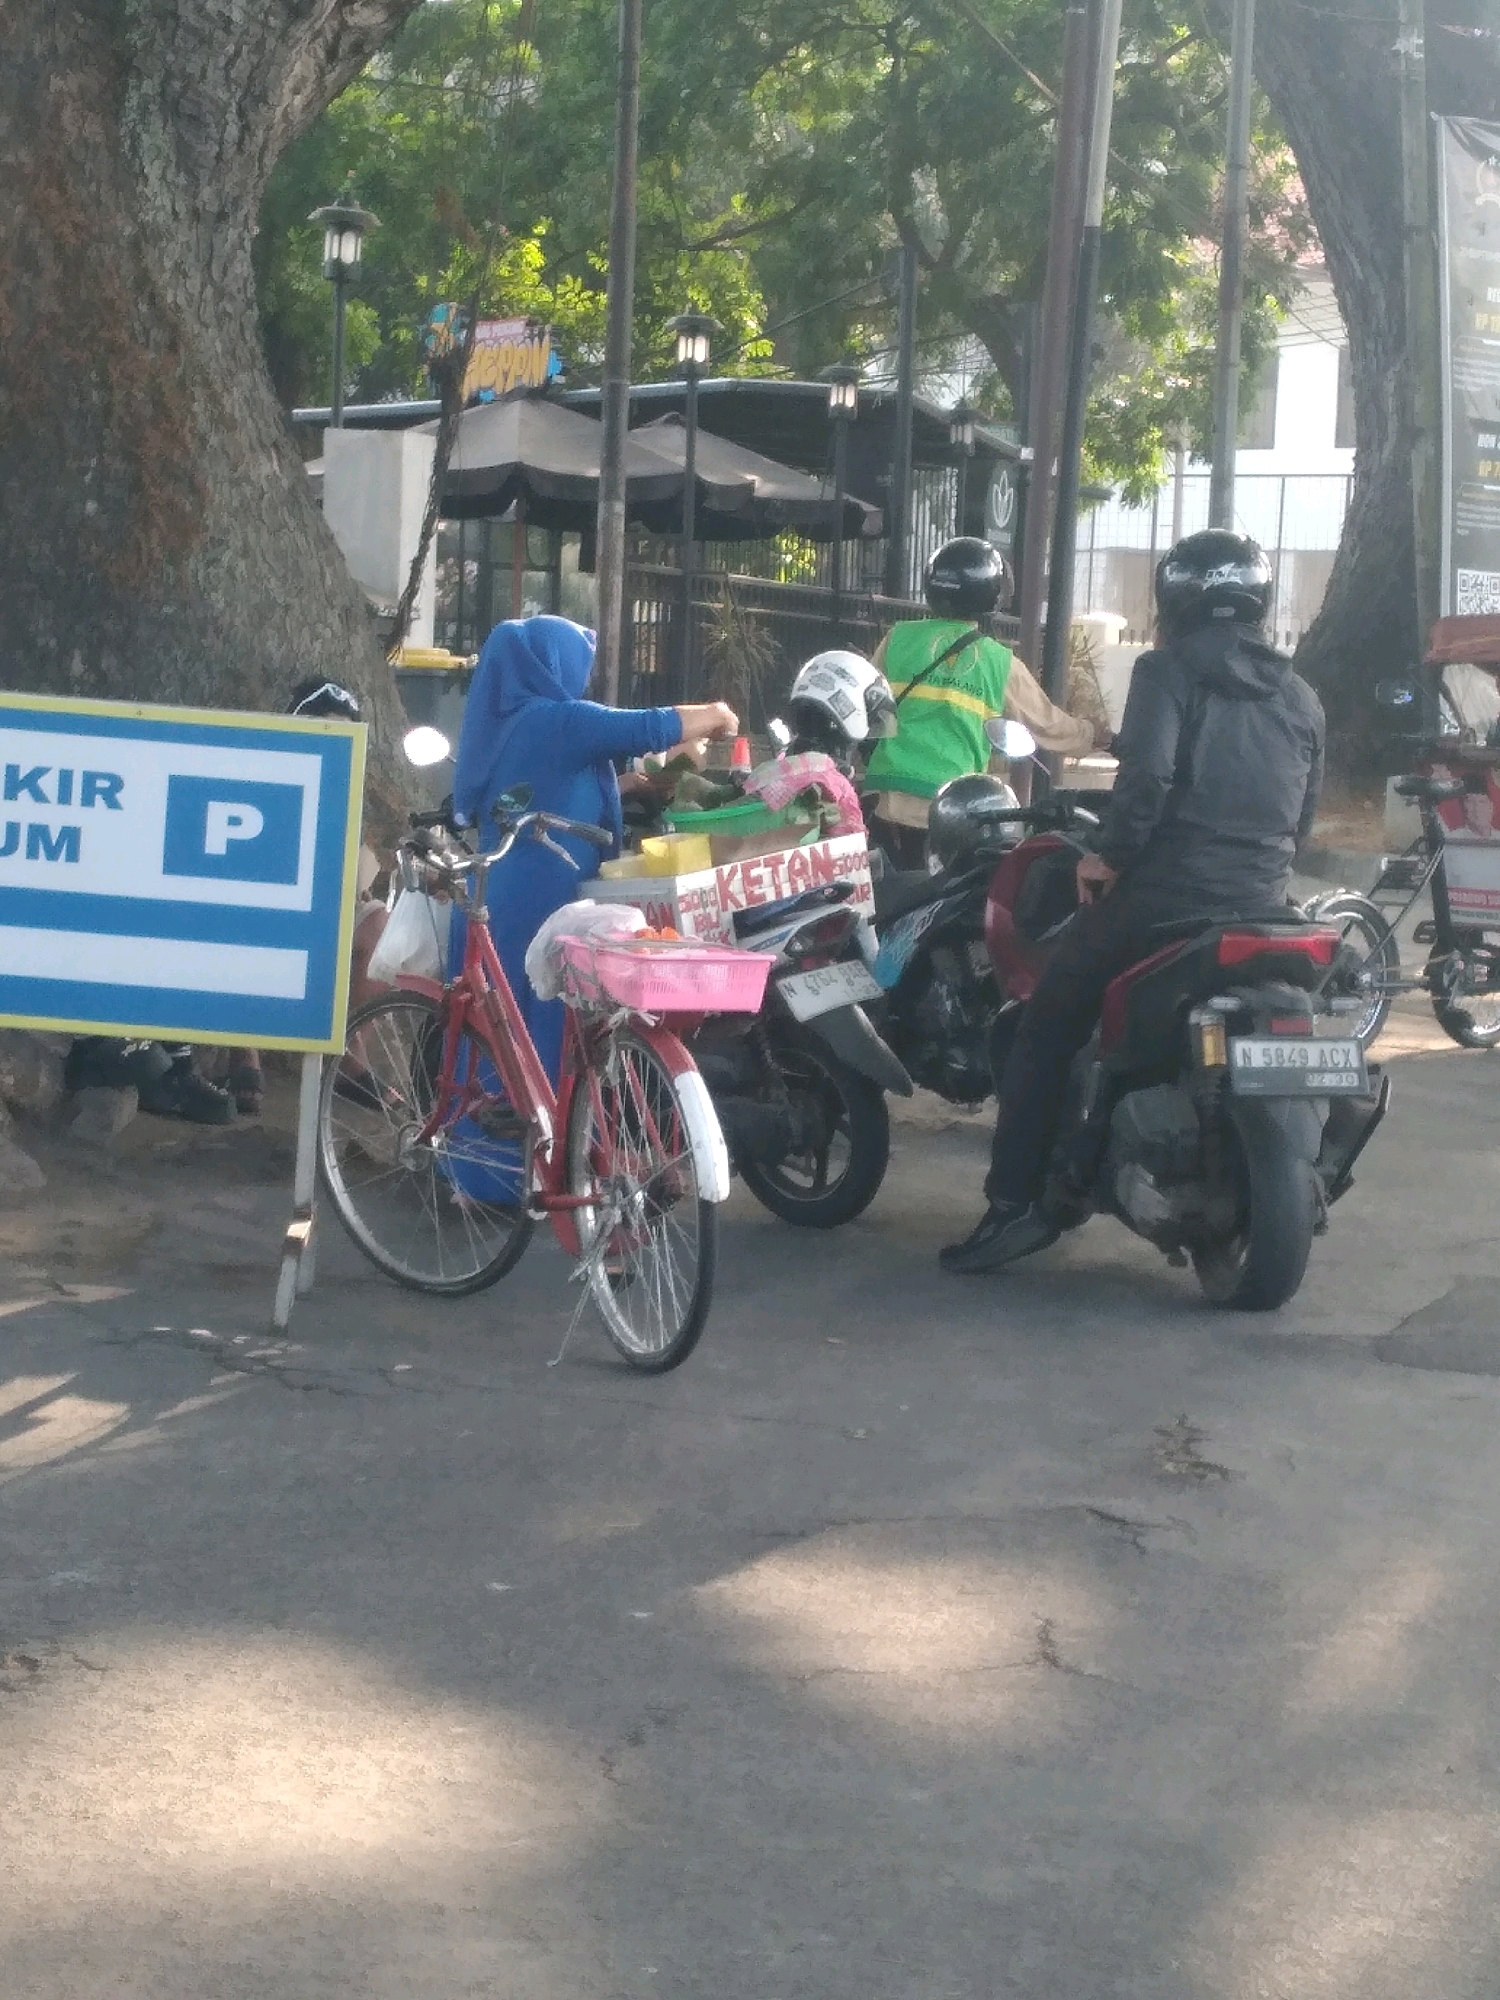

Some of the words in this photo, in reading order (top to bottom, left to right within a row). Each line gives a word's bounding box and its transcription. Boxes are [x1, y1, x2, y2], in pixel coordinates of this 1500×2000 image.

[3, 763, 125, 810] KIR
[204, 801, 264, 855] P
[715, 842, 836, 912] KETAN
[783, 982, 798, 998] N
[1242, 1047, 1252, 1066] N
[1262, 1047, 1309, 1066] 5849
[1319, 1047, 1353, 1068] ACX
